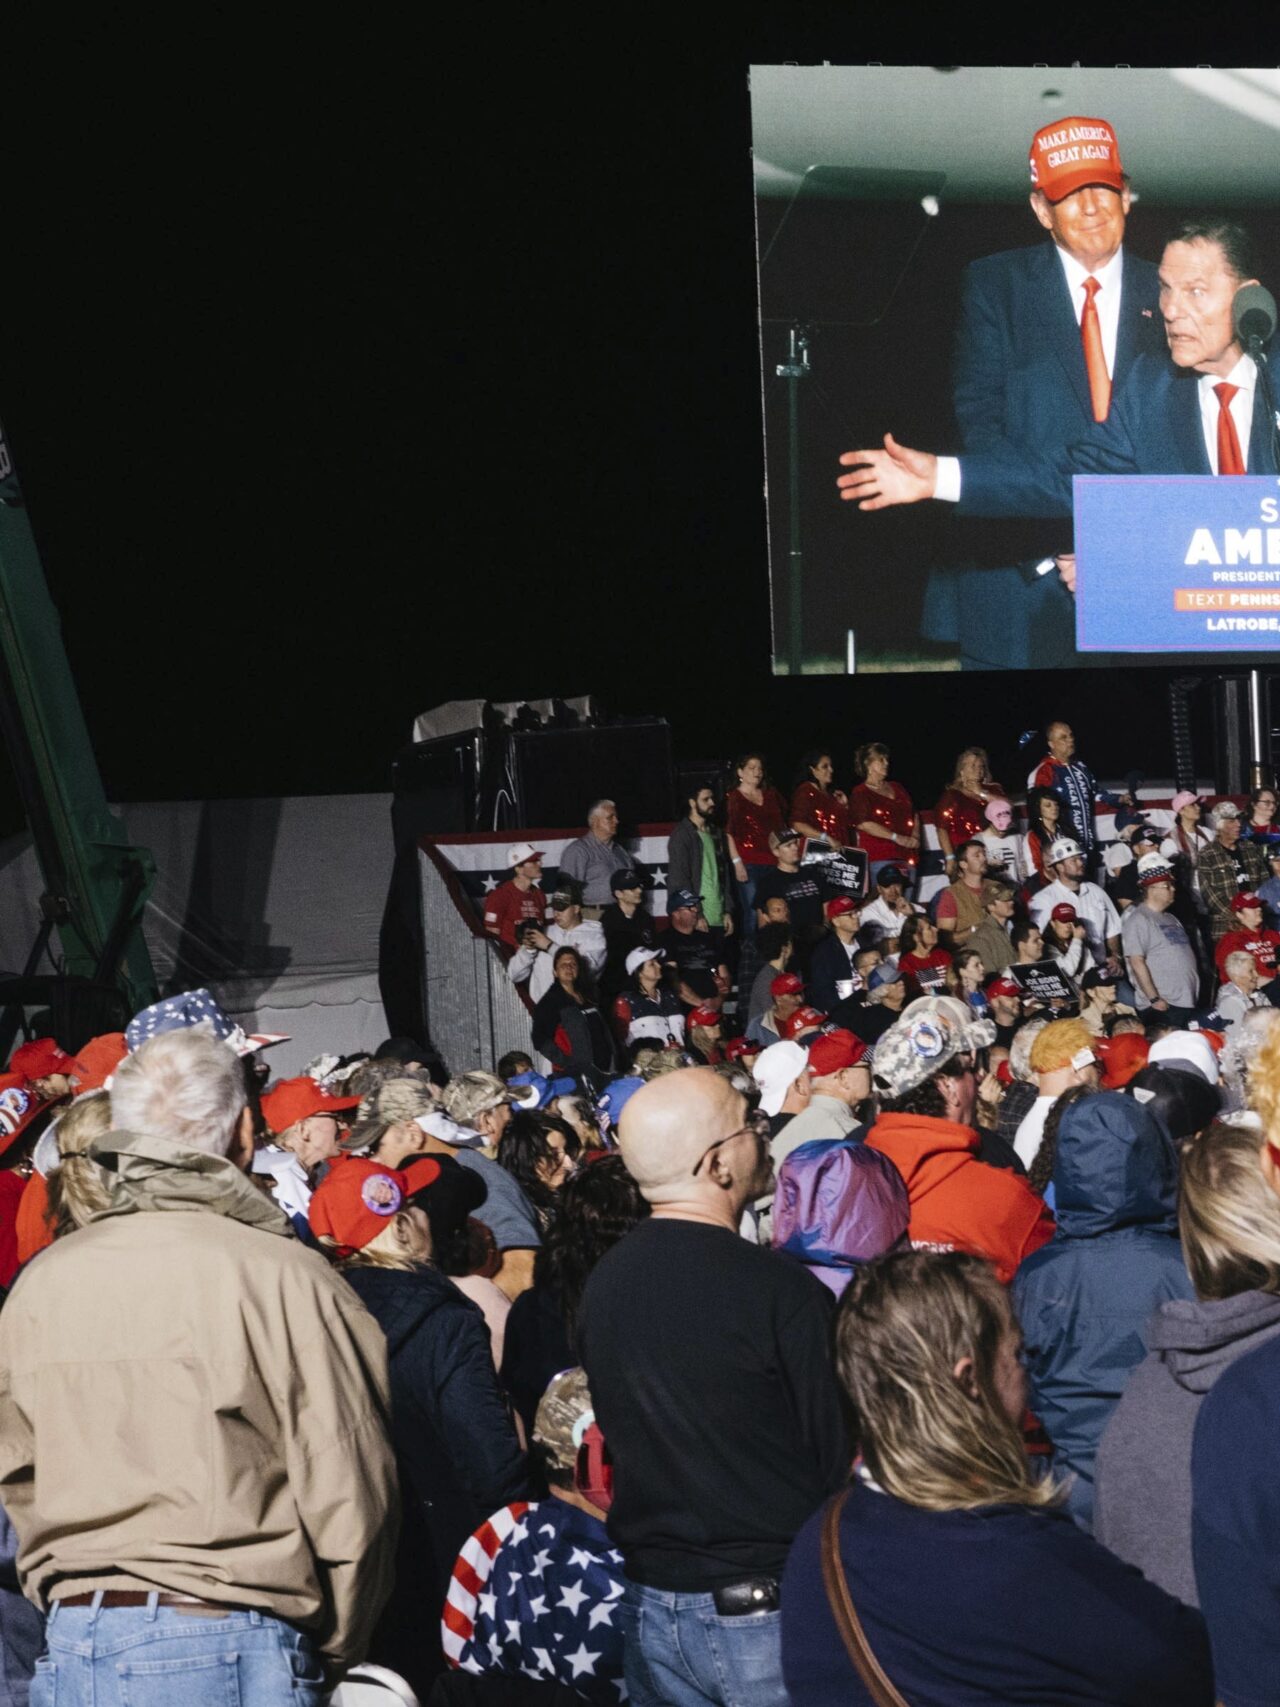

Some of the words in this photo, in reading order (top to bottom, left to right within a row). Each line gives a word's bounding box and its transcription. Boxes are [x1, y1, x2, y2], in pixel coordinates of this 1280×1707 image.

[1037, 130, 1068, 151] MAKE
[1069, 126, 1113, 143] AMERICA
[1047, 146, 1080, 168] GREAT
[1082, 144, 1110, 160] AGAIN
[1212, 571, 1280, 582] PRESIDENT
[1187, 593, 1225, 606] TEXT
[1064, 776, 1080, 807] GREAT
[831, 861, 859, 874] BIDEN
[1025, 978, 1039, 986] JOE
[1037, 975, 1061, 985] BIDEN
[1030, 983, 1051, 992] OWES
[1049, 982, 1064, 990] ME
[1044, 988, 1070, 998] MONEY
